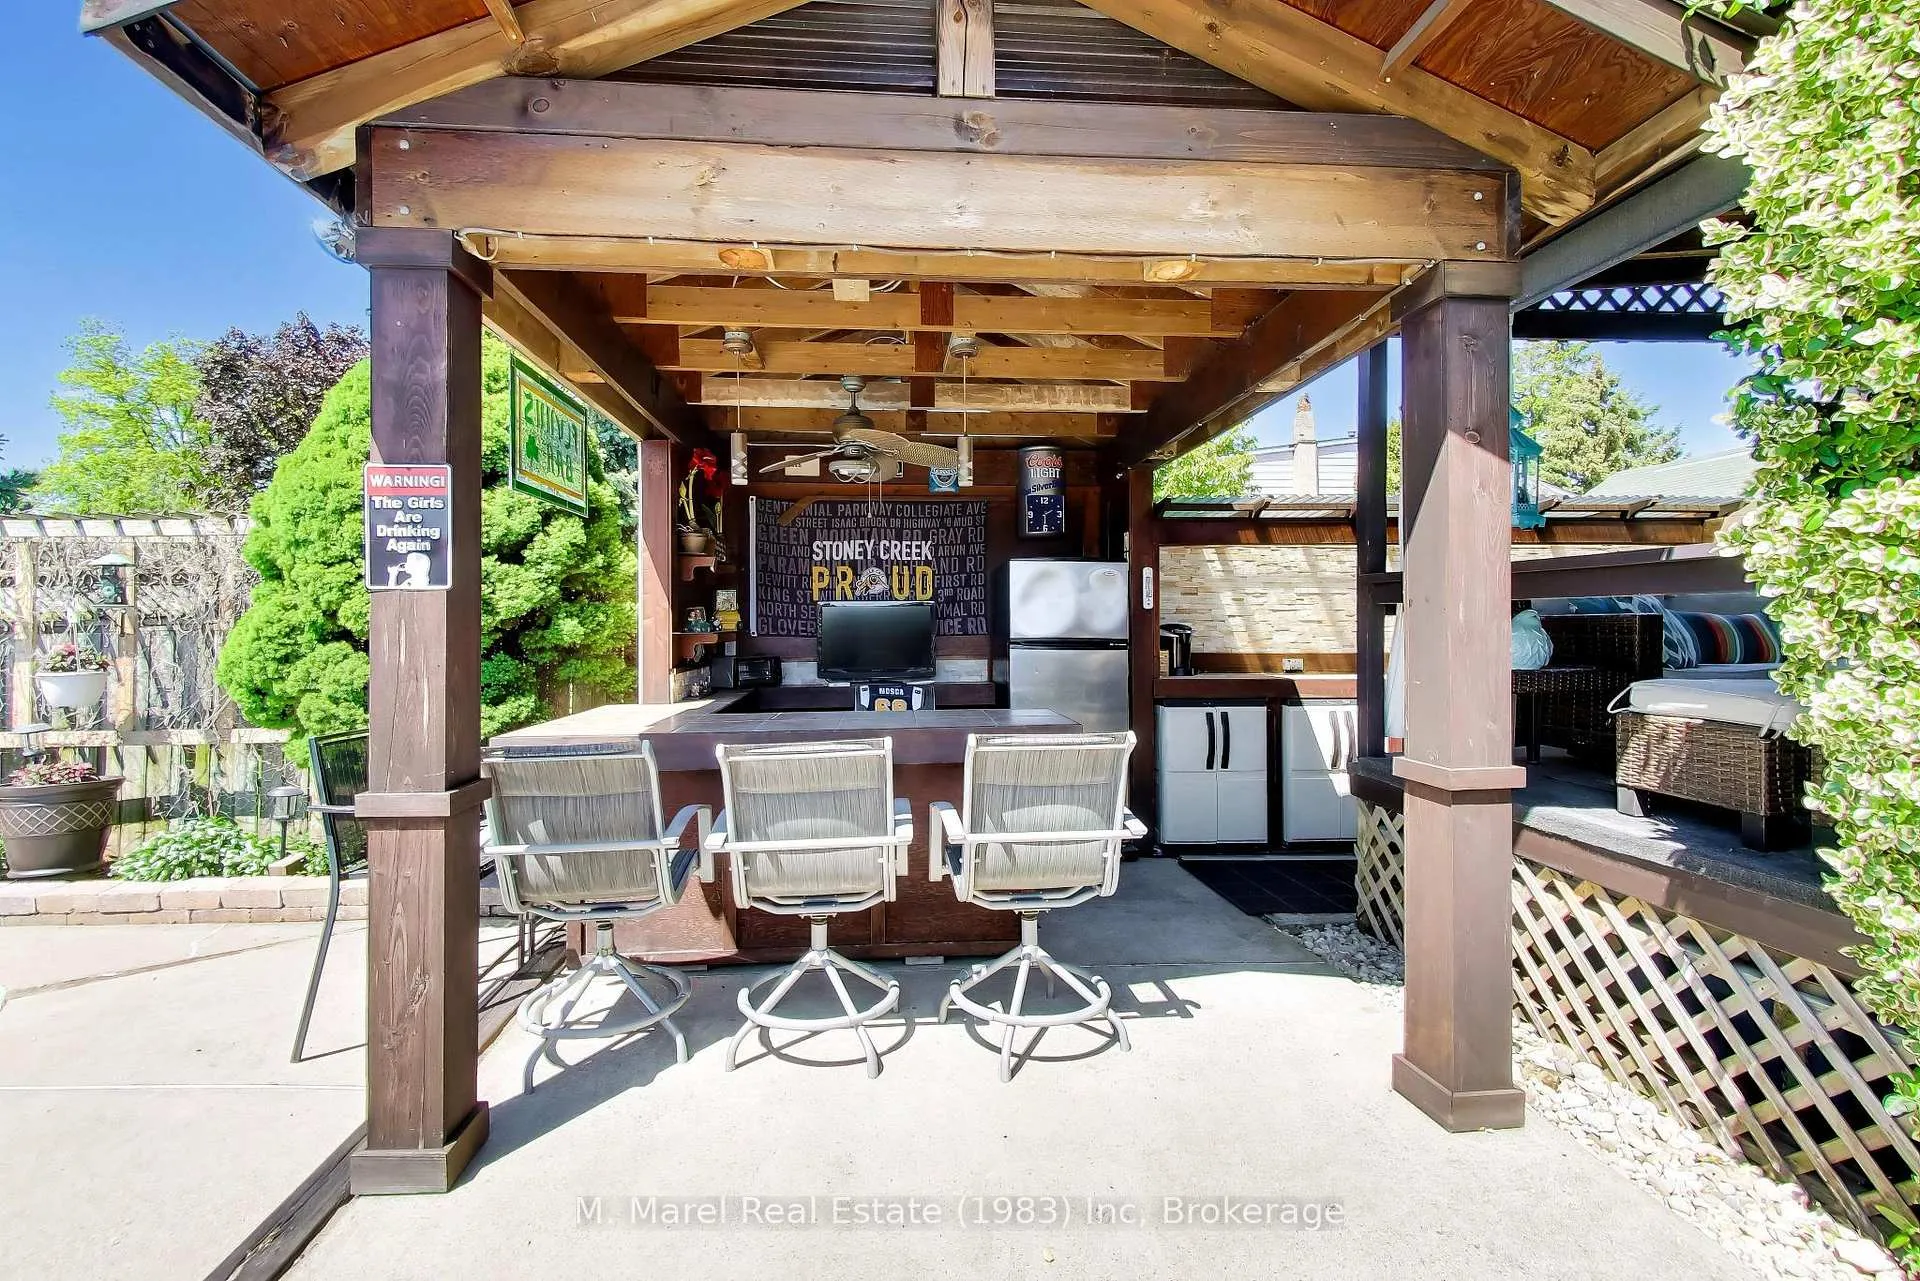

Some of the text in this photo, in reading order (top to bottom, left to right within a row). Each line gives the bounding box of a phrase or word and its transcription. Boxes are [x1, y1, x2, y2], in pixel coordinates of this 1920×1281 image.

[1026, 453, 1063, 468] Coors
[370, 475, 446, 487] WARNING!
[1031, 467, 1061, 478] LIGHT
[371, 496, 444, 509] The Girls
[837, 502, 892, 517] PARKWAY
[896, 503, 962, 518] COLLEGIATE
[966, 500, 987, 516] AVE
[394, 510, 423, 523] Are
[795, 517, 828, 529] STREET
[831, 518, 857, 529] ISAAC
[903, 518, 941, 529] HIGHWAY
[953, 517, 973, 528] MUD
[975, 515, 986, 526] ST
[376, 524, 441, 540] Drinking
[757, 524, 809, 546] GREEN
[929, 528, 963, 545] GRAY
[968, 526, 985, 543] RD
[386, 537, 431, 554] Again
[757, 543, 811, 558] FRUITLAND
[937, 544, 966, 557] ARVIN
[968, 543, 986, 555] AVE
[812, 539, 875, 562] STONEY
[880, 539, 933, 561] CREEK
[966, 556, 985, 573] RD
[757, 571, 798, 589] DEWITT
[934, 573, 967, 588] FIRST
[970, 572, 985, 586] RD
[757, 586, 790, 602] KING
[796, 590, 813, 604] ST
[957, 586, 985, 601] ROAD
[757, 600, 797, 618] NORTH
[970, 601, 985, 615] RD
[967, 617, 988, 634] RD
